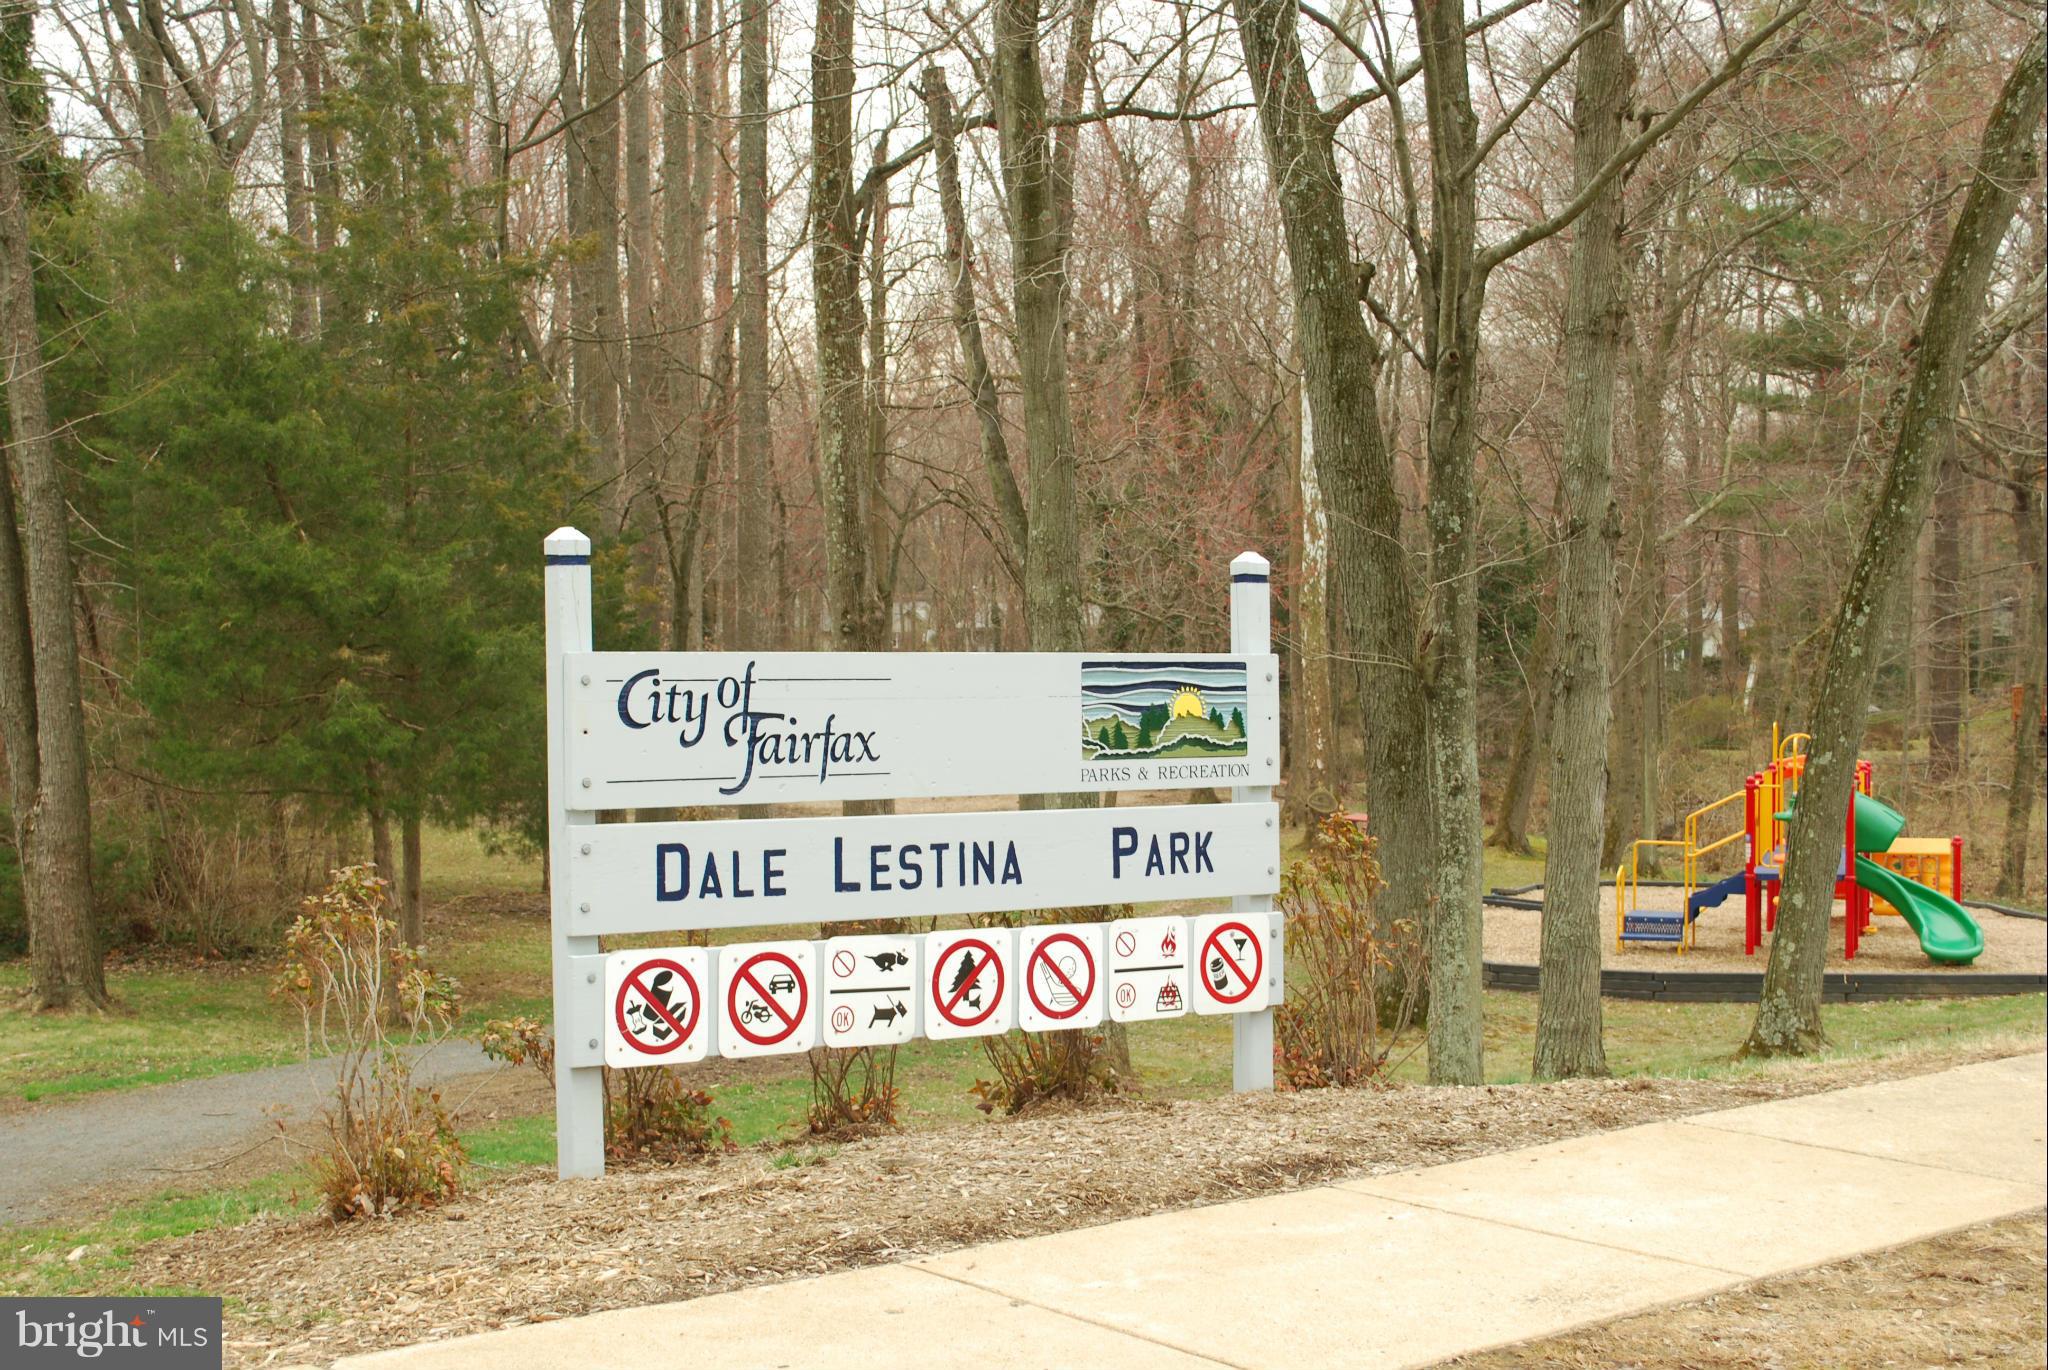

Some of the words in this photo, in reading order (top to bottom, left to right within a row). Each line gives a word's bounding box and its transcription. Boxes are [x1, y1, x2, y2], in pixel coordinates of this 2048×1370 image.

[617, 668, 709, 748] City
[717, 660, 756, 735] of
[718, 711, 881, 795] Fairfax
[1081, 766, 1131, 783] PARKS
[1137, 767, 1148, 781] &
[1158, 763, 1250, 780] RECREATION
[656, 843, 787, 902] DALE
[834, 836, 1023, 893] LESTINA
[1112, 826, 1214, 879] PARK
[836, 1011, 849, 1027] OK
[1120, 989, 1132, 1002] OK
